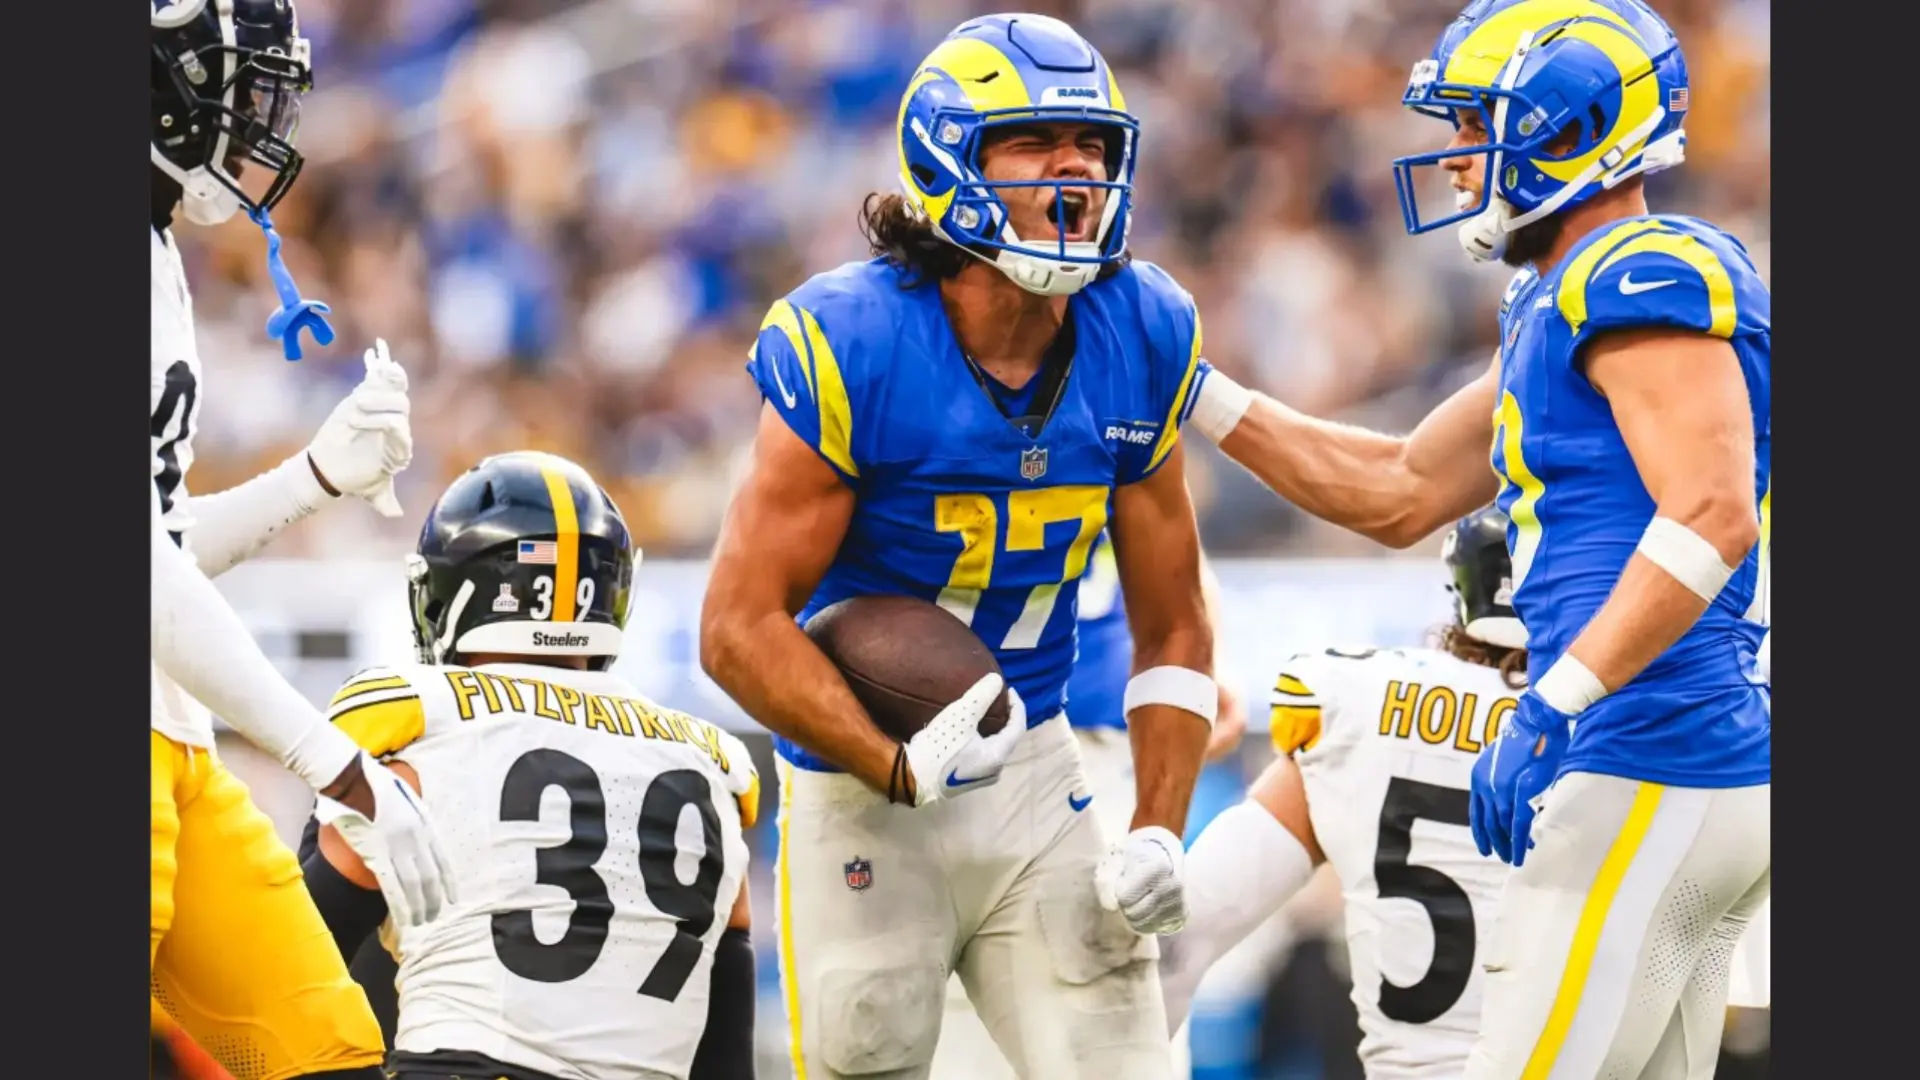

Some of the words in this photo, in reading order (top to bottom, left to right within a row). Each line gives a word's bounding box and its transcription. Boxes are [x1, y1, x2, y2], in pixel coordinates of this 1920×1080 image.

[1057, 88, 1098, 99] RAMS
[1105, 426, 1155, 445] RAMS
[532, 631, 589, 647] Steelers
[445, 671, 730, 774] FITZPATRICK
[491, 748, 724, 1002] 39
